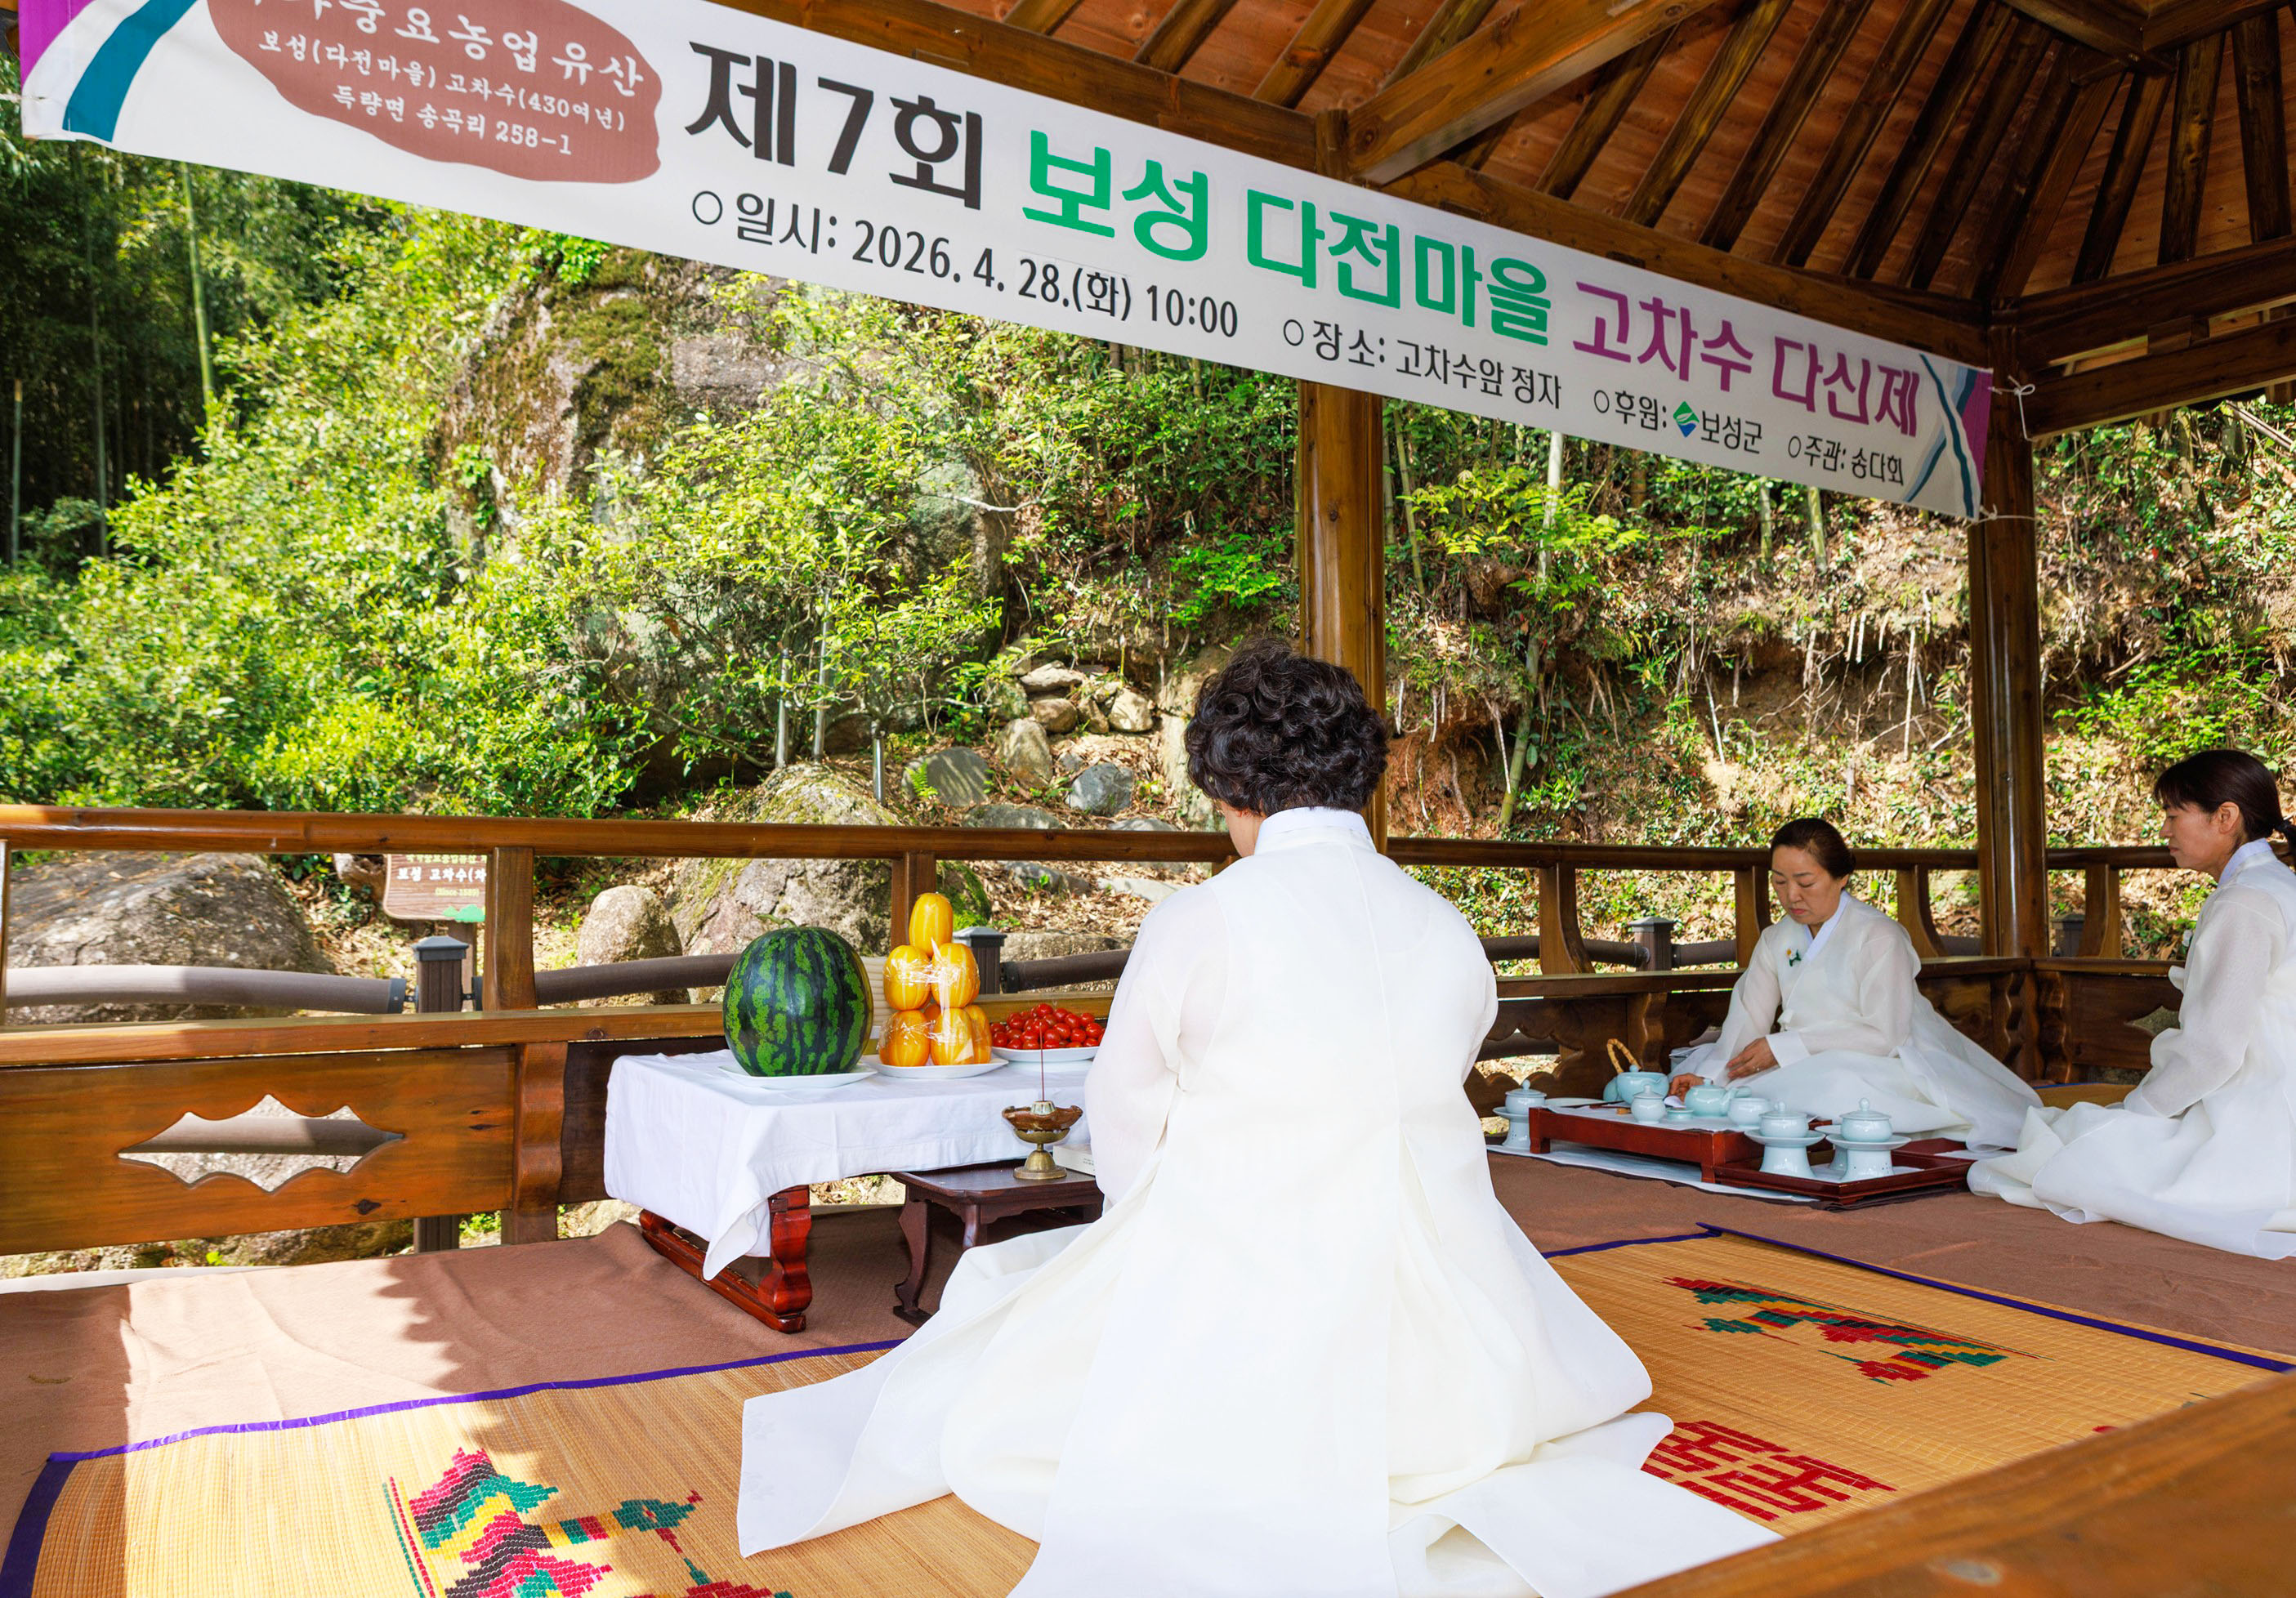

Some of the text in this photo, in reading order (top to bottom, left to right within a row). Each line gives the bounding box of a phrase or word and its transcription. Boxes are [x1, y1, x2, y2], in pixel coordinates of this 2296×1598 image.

[254, 0, 645, 97] 중요농업유산
[258, 30, 436, 89] 보성(다전마을)
[333, 84, 572, 155] 득량면 송곡리 258-1
[685, 41, 1921, 437] 제7회 보성 다전마을 고차수 다신제
[1146, 284, 1239, 338] 10:00
[1512, 366, 1562, 409] 정자
[1700, 410, 1763, 454] 보성군
[1852, 447, 1904, 485] 송다회
[397, 867, 422, 882] 보성
